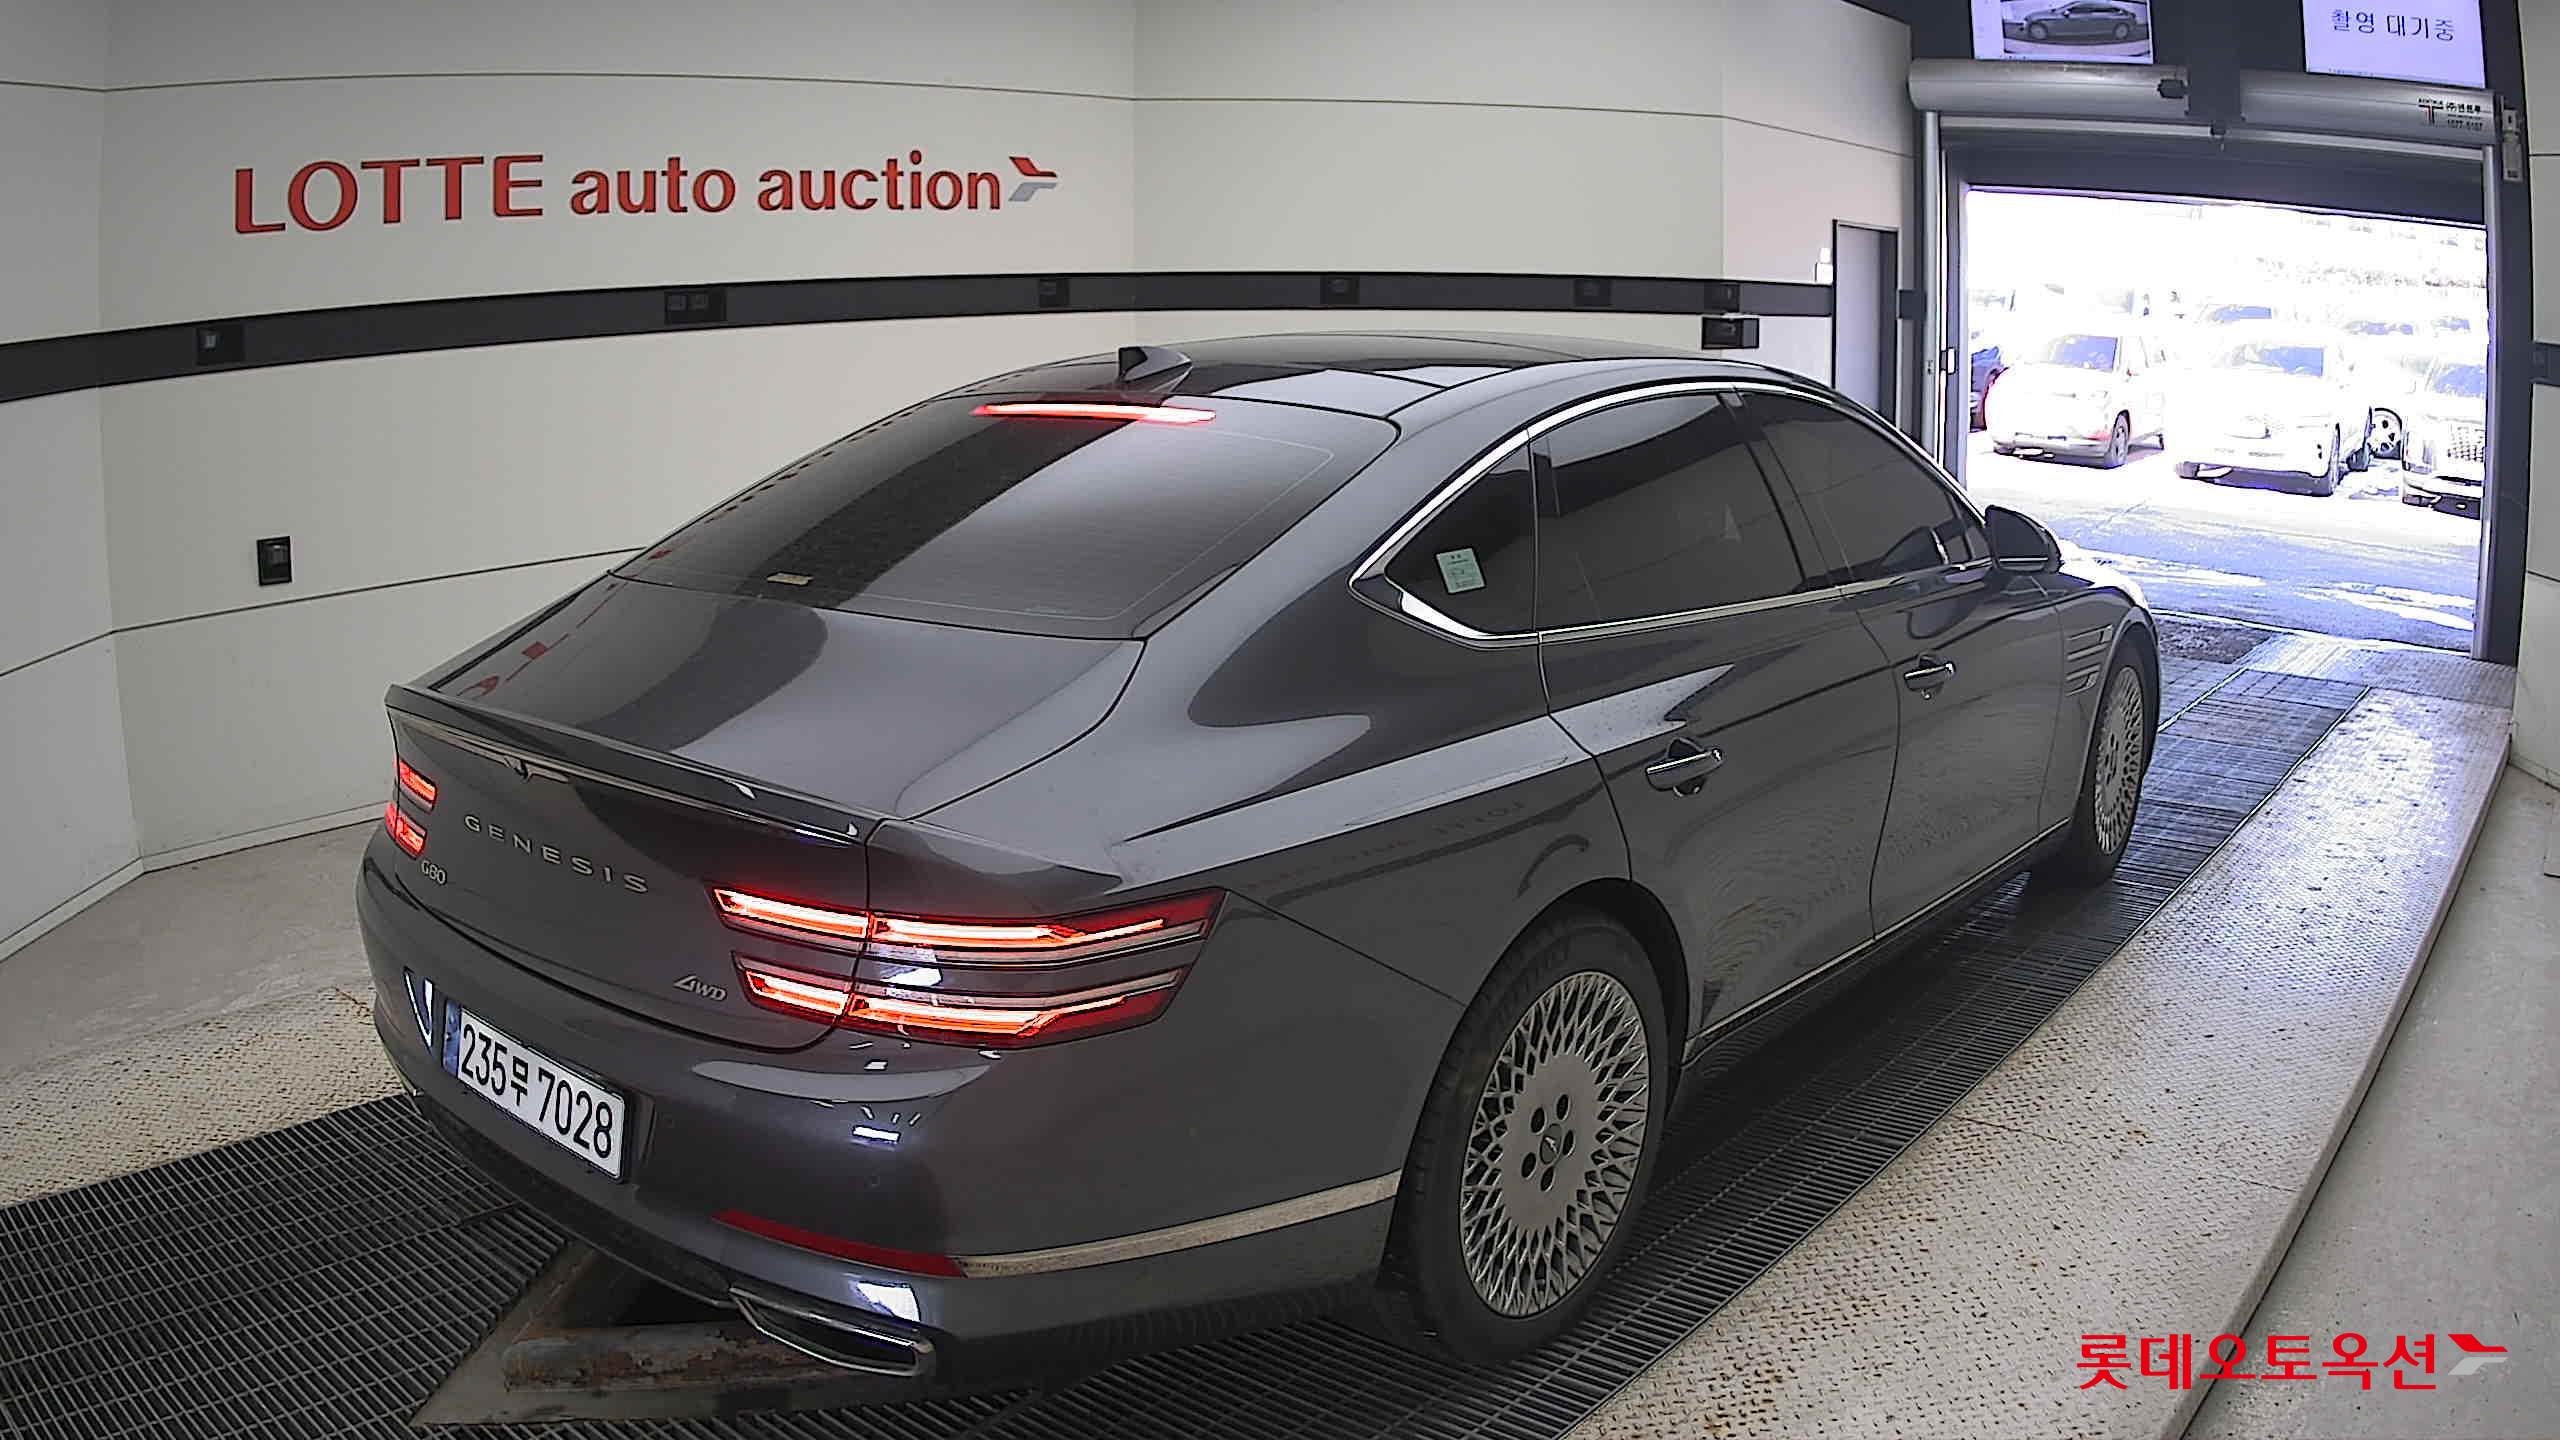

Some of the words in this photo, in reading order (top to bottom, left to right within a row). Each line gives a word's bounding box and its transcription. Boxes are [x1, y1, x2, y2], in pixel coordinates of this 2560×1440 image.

[235, 154, 544, 233] LOTTE
[570, 156, 736, 214] auto
[758, 150, 1001, 211] auction
[421, 859, 447, 885] G80
[464, 814, 648, 893] GENESIS
[538, 1066, 613, 1158] 7028
